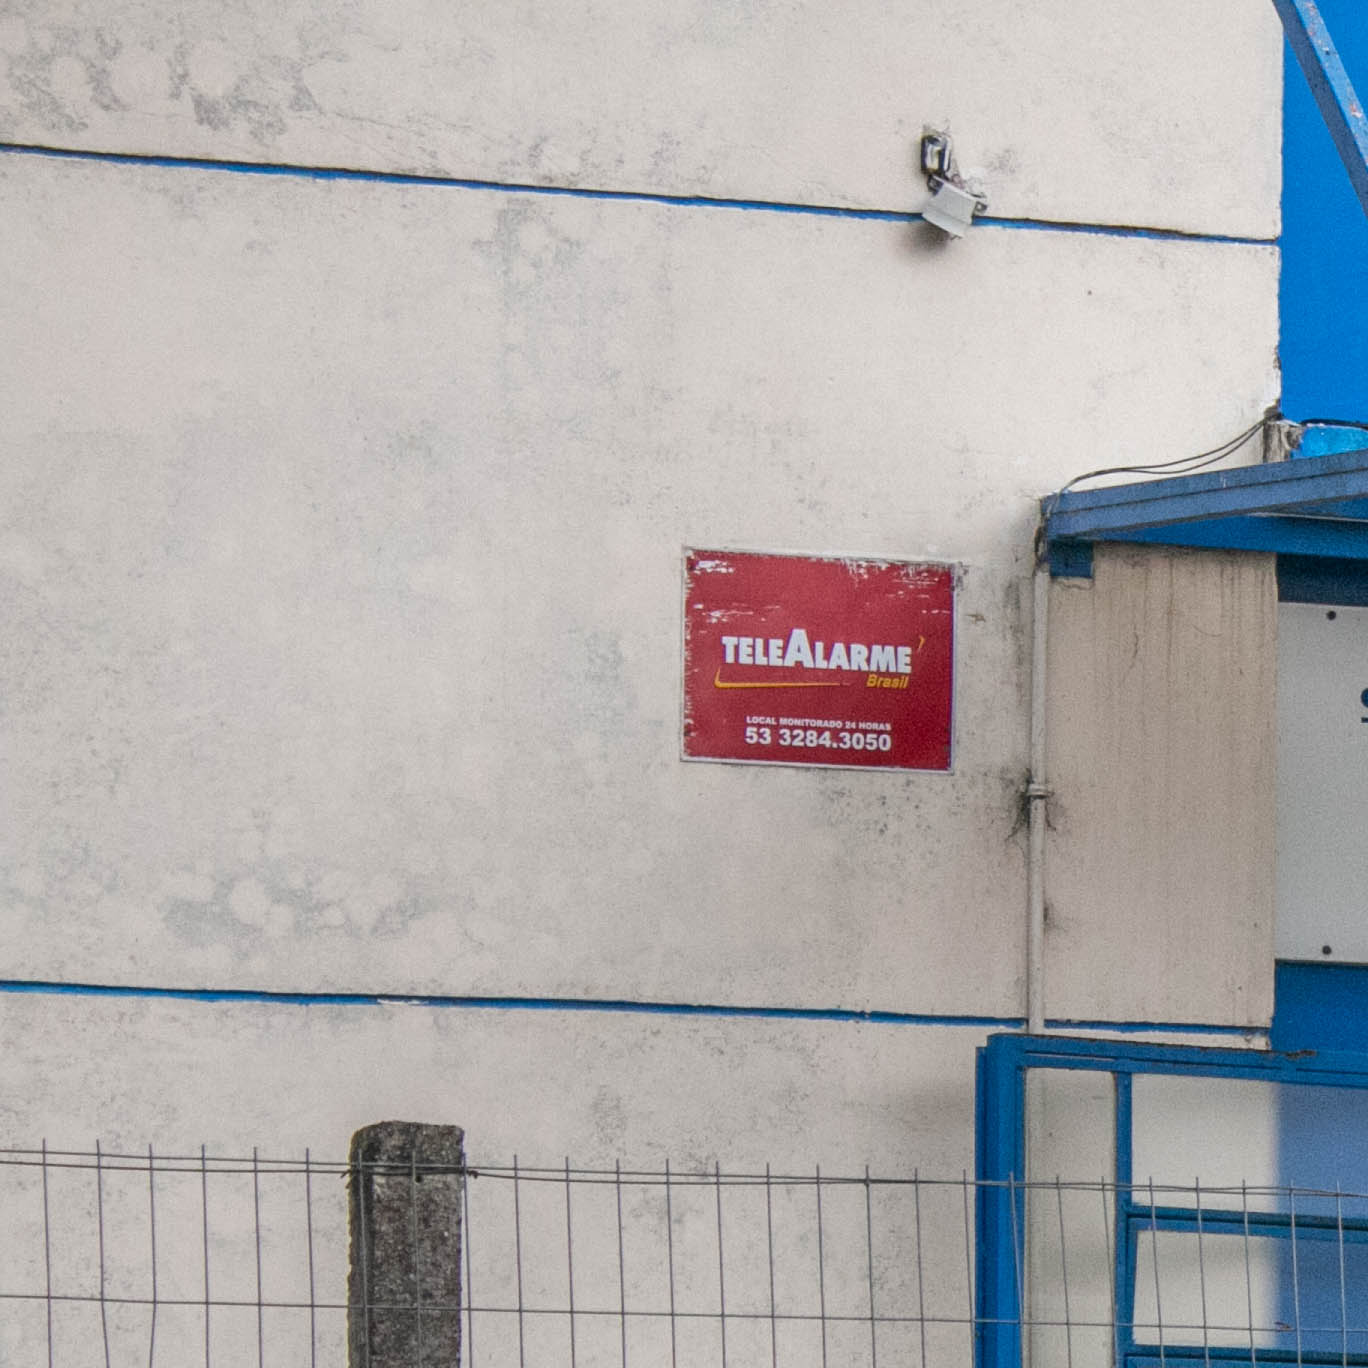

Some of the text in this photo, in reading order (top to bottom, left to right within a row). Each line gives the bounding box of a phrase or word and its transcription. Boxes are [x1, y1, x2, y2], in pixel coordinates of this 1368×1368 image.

[866, 673, 909, 688] Brasil
[746, 715, 892, 731] LOCAL MONITORADO 24 HORAS
[745, 727, 892, 752] 53 3284.3050
